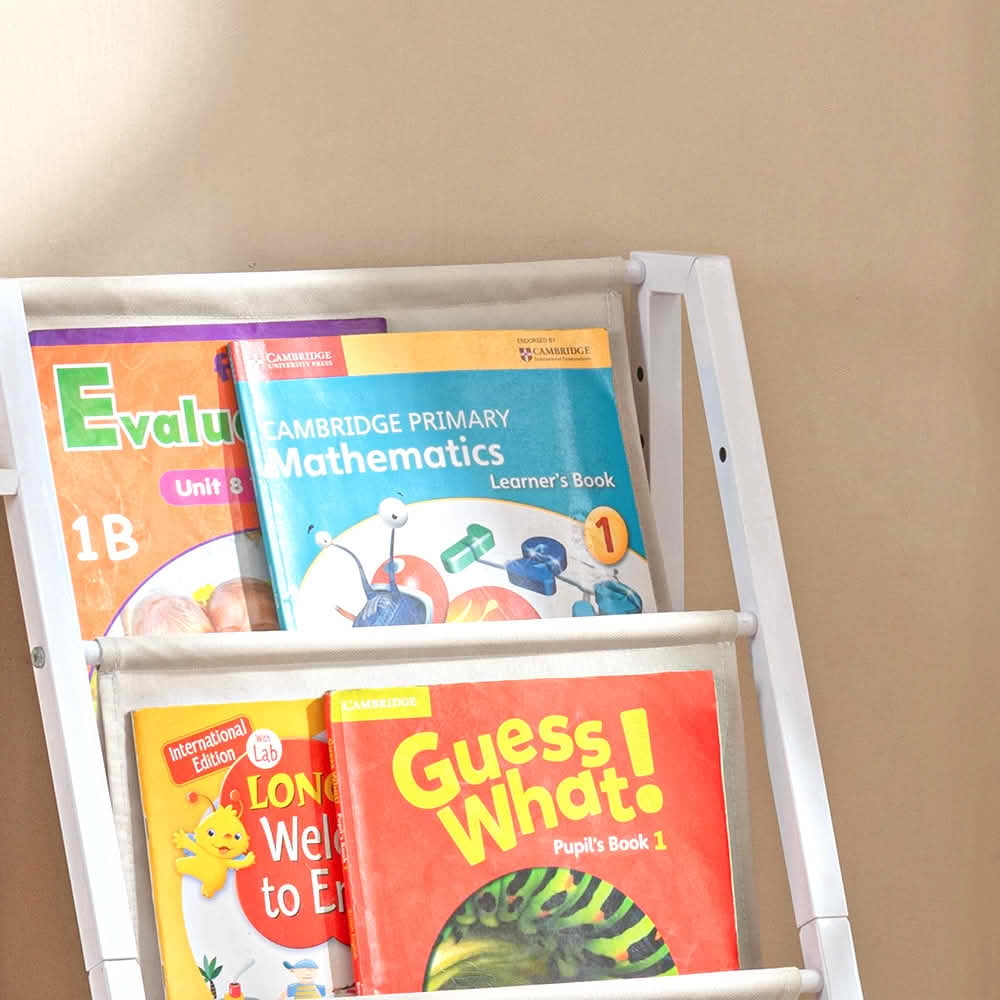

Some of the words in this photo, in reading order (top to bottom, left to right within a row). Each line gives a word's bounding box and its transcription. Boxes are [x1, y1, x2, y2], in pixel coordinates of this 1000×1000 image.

[266, 351, 333, 363] CAMBRIDGE
[533, 346, 591, 355] CAMBRIDGE
[268, 361, 311, 369] UNIVERSITY
[266, 412, 402, 441] CAMBRIDGE
[408, 408, 511, 433] PRIMARY
[263, 436, 505, 479] Mathematics
[175, 476, 222, 497] Unit
[228, 477, 244, 496] 8
[490, 473, 568, 490] Learner's
[572, 471, 616, 489] Book
[71, 513, 140, 562] 1B
[595, 516, 614, 553] 1
[341, 695, 417, 712] CAMBRIDGE
[168, 718, 248, 763] International
[253, 744, 278, 763] Lab
[192, 748, 237, 774] Edition
[392, 714, 612, 810] Guess
[436, 707, 663, 866] What!
[553, 837, 604, 859] Pupil's
[608, 833, 649, 852] Book
[653, 831, 667, 851] 1
[262, 876, 301, 919] to
